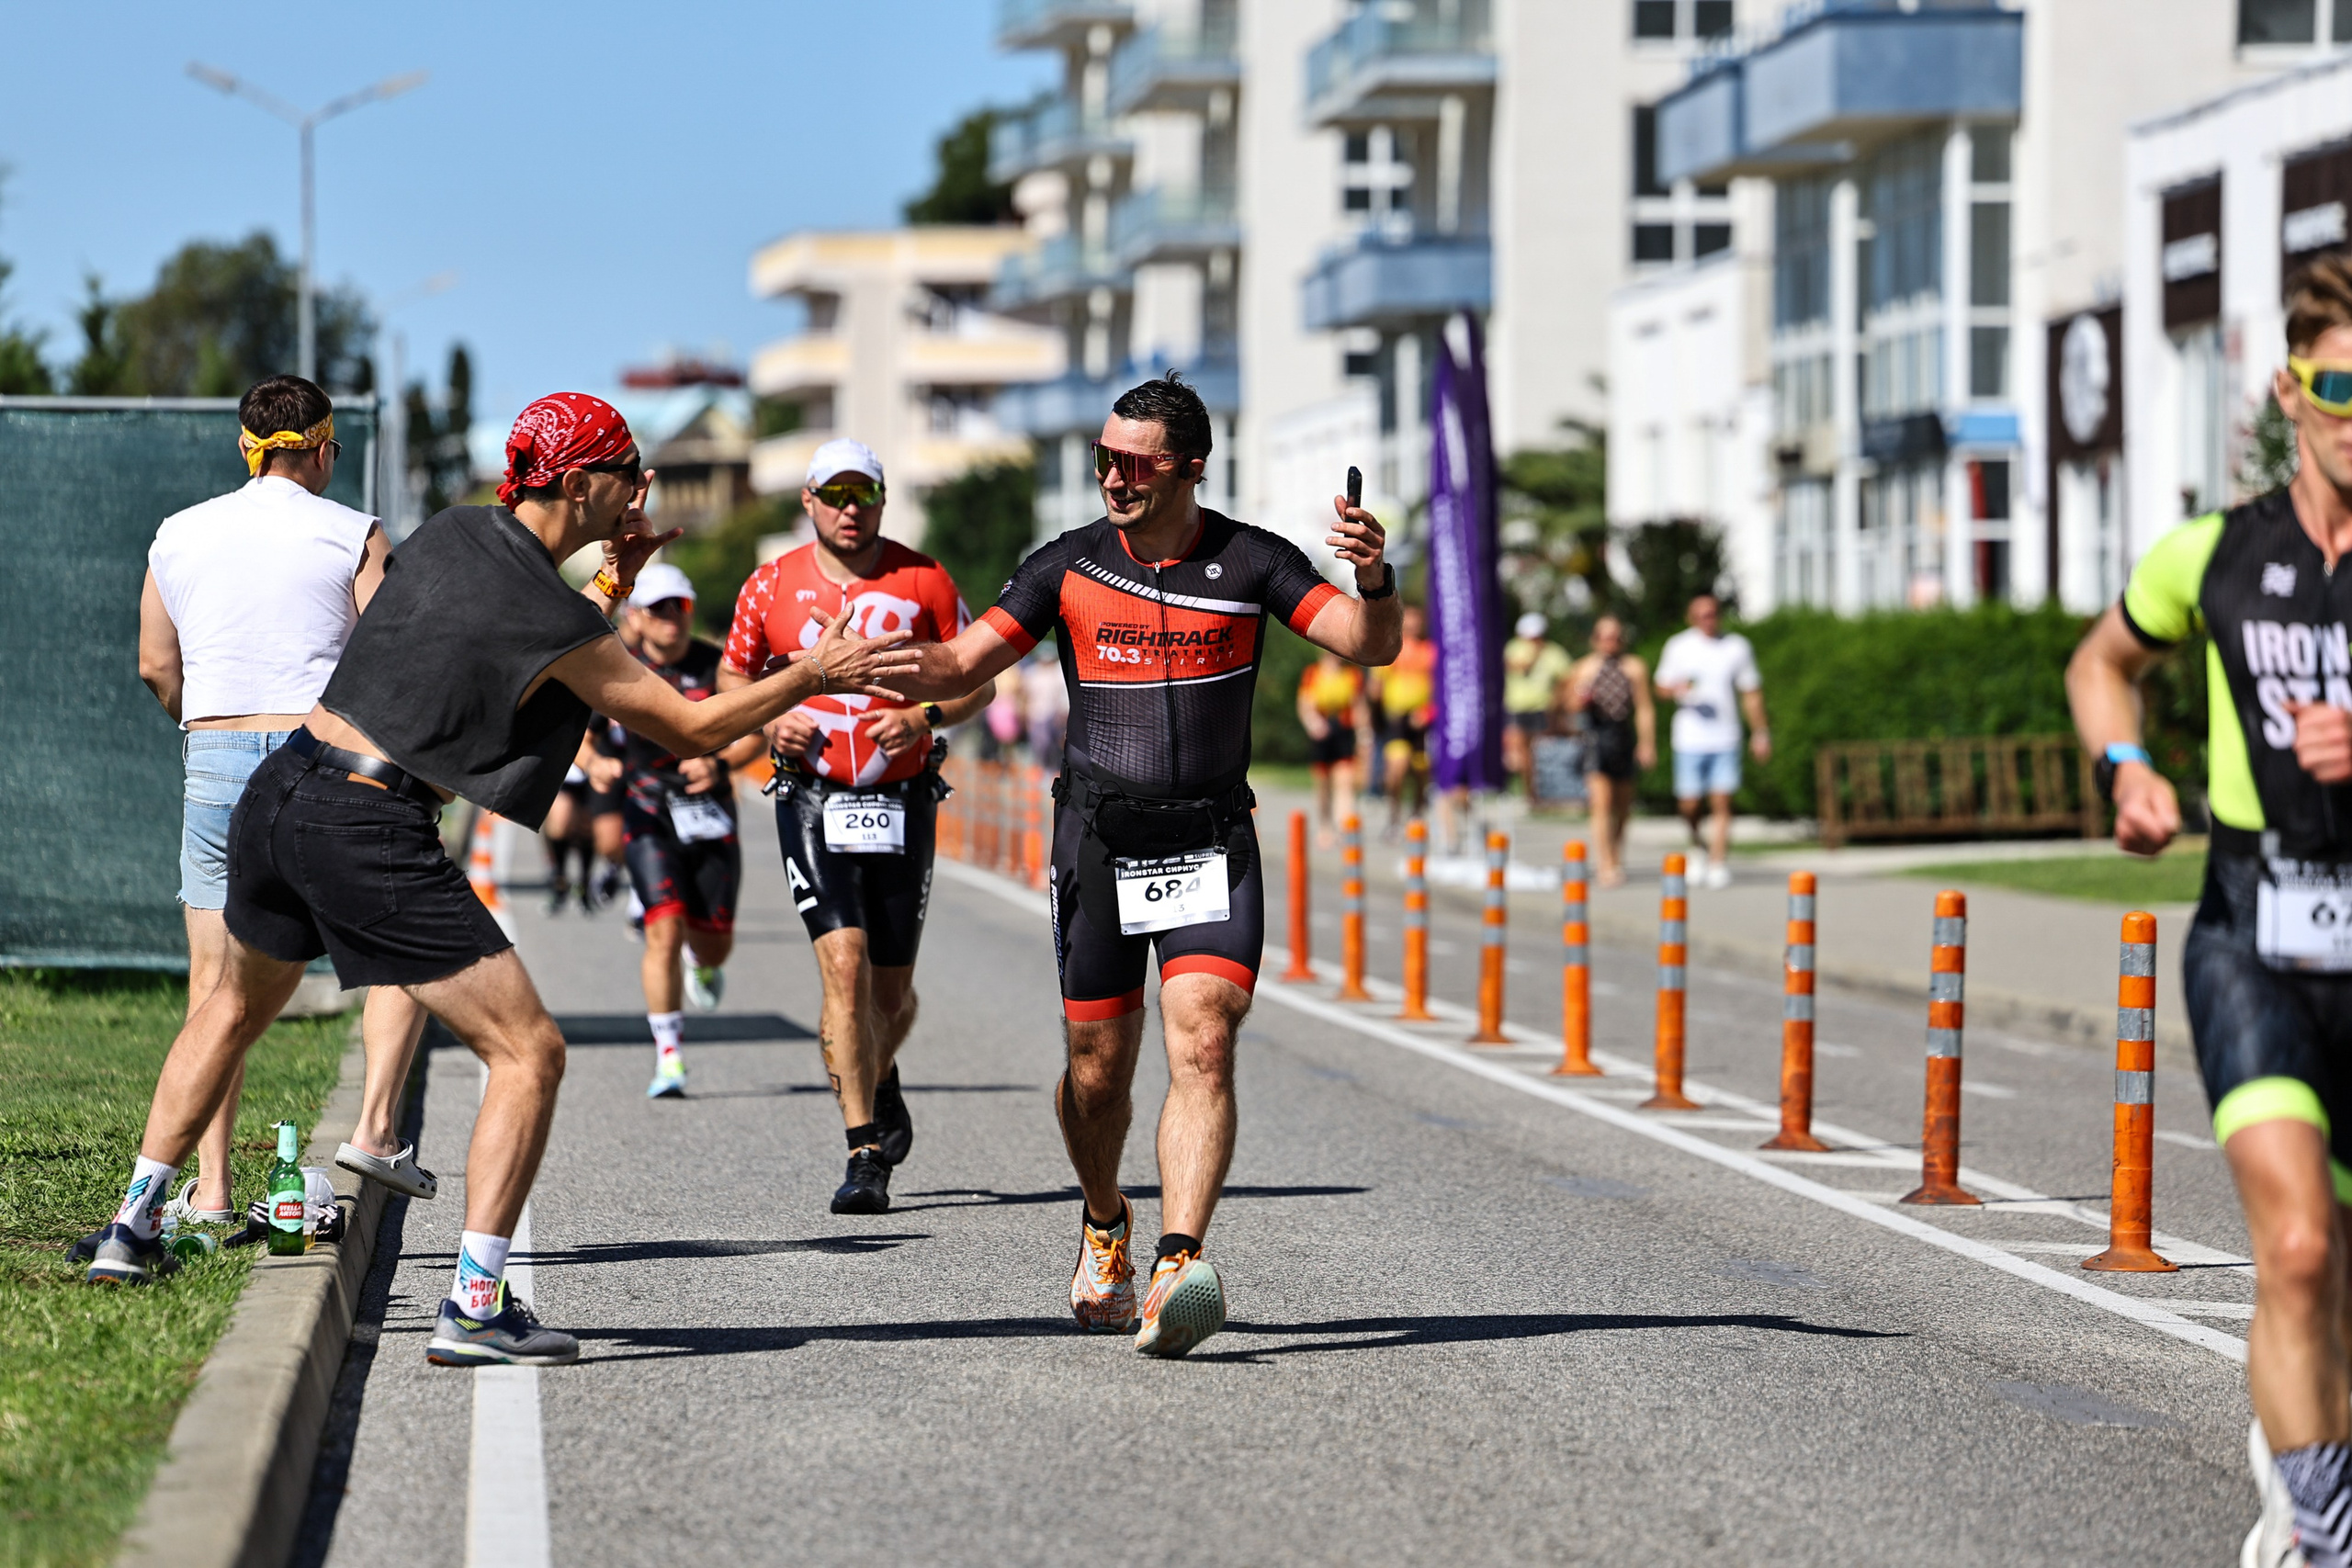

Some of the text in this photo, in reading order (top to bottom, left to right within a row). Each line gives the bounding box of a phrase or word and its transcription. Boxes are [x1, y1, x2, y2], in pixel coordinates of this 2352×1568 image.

[1099, 621, 1138, 629] POWERED
[1096, 626, 1233, 648] RIGHTRACK
[1095, 643, 1234, 664] 70.3 TRATHLON
[2242, 619, 2352, 678] IRON
[845, 813, 890, 829] 260
[1121, 867, 1163, 879] IRONSTAR
[1165, 863, 1200, 874] СИРИУС
[1145, 876, 1201, 902] 684
[469, 1279, 499, 1292] НОГА
[470, 1292, 499, 1308] БОГА
